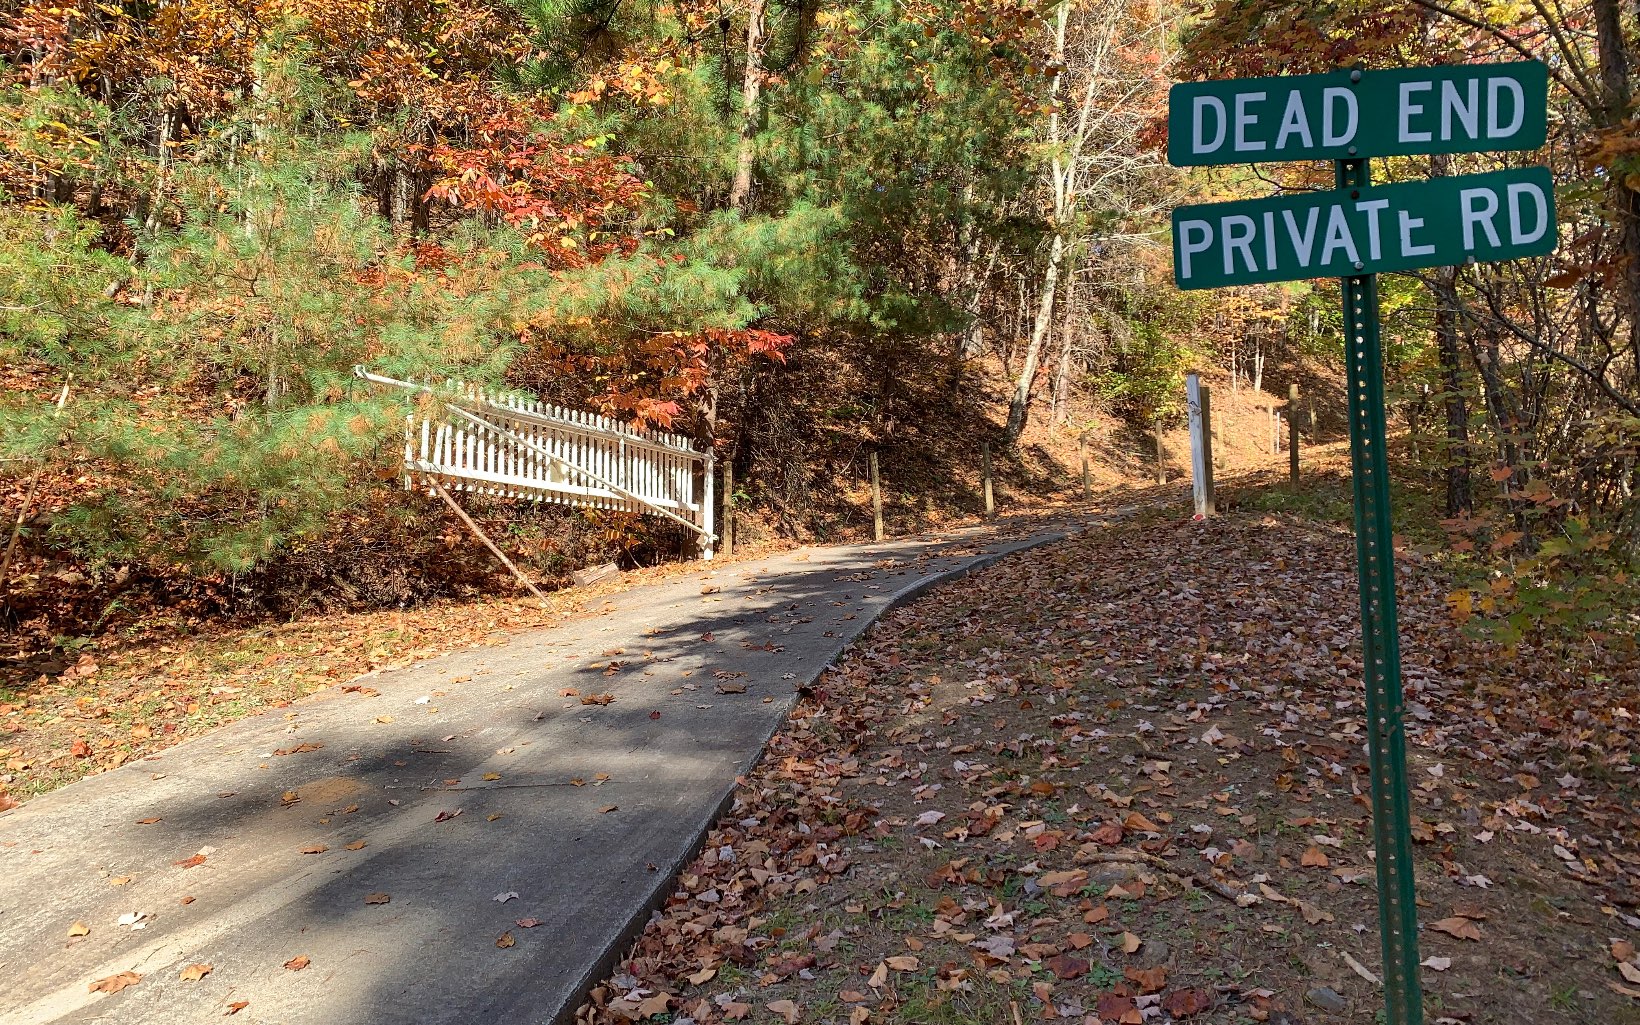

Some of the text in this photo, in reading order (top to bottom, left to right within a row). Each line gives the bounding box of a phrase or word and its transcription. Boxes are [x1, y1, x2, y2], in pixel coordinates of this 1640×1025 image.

[1192, 76, 1525, 154] DEAD END
[1178, 182, 1548, 278] PRIVATE RD
